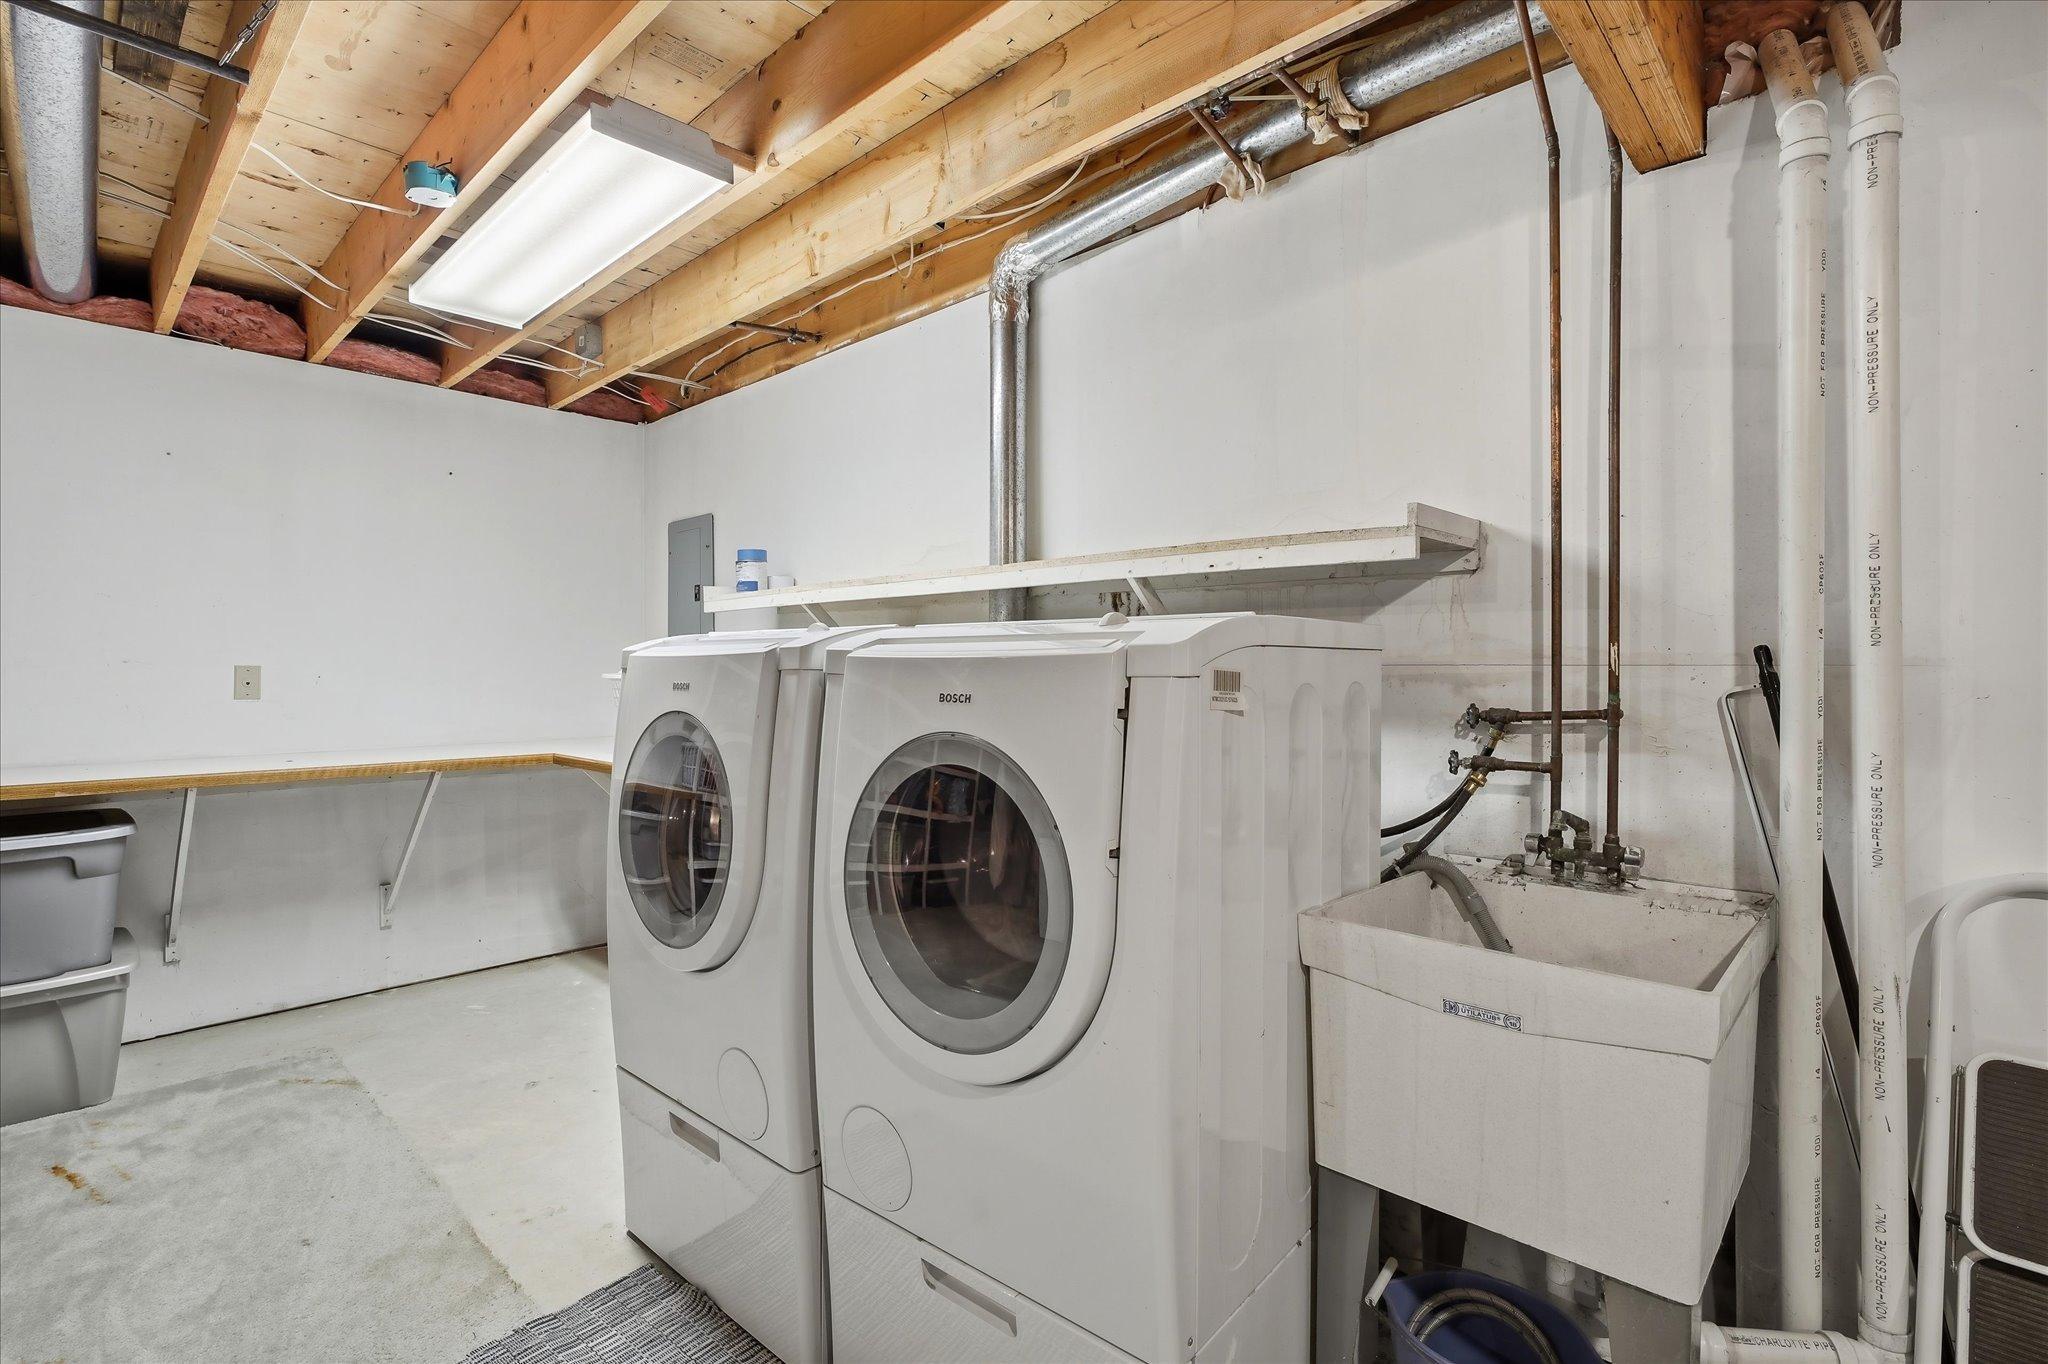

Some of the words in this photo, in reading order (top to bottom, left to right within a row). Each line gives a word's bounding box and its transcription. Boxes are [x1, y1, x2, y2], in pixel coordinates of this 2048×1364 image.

[1866, 296, 1878, 323] ONLY
[1866, 329, 1879, 413] NON-PRESSURE
[1868, 532, 1880, 560] ONLY
[1869, 566, 1881, 647] NON-PRESSURE
[672, 682, 690, 691] BOSCH
[939, 693, 971, 703] BOSCH
[1870, 752, 1882, 780] ONLY
[1870, 786, 1883, 869] NON-PRESSURE
[1873, 986, 1884, 1014] ONLY
[1872, 1019, 1885, 1101] NON-PRESSURE
[1875, 1204, 1886, 1234] ONLY
[1875, 1237, 1887, 1322] NON-PRESSURE
[1754, 1337, 1810, 1350] CHARLOTTE
